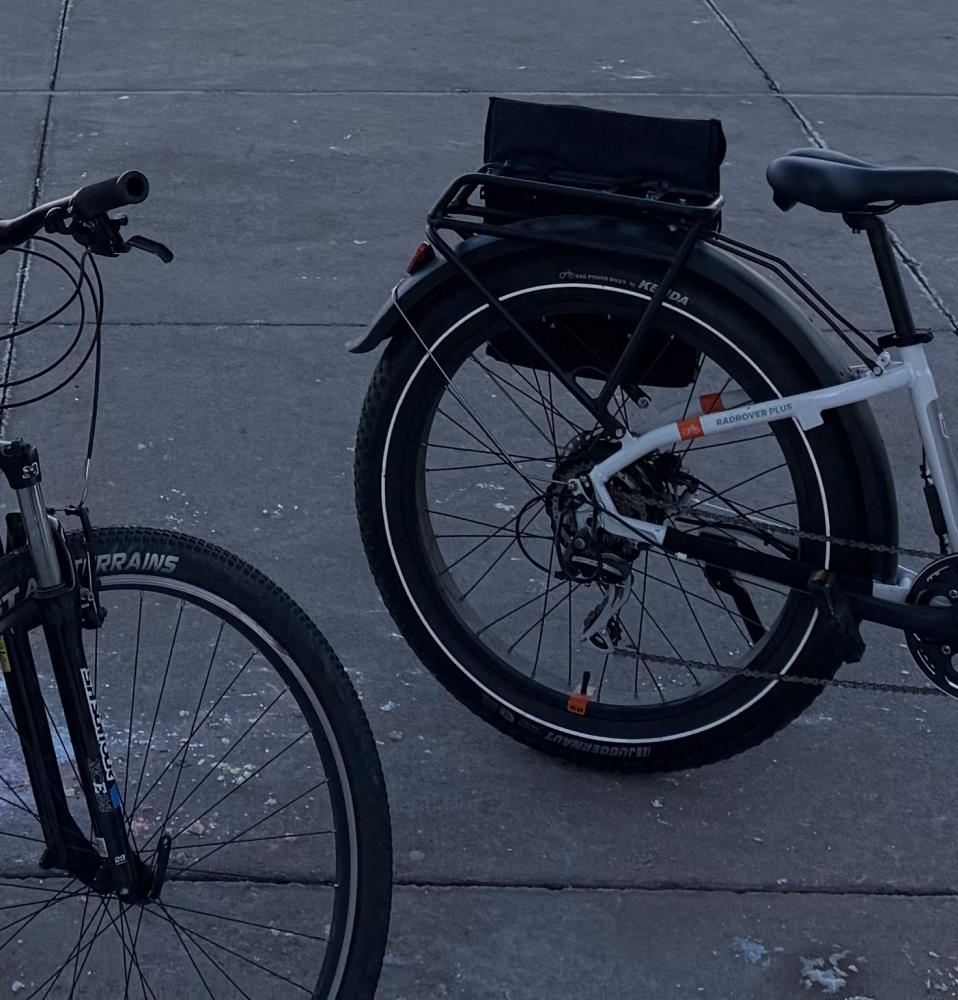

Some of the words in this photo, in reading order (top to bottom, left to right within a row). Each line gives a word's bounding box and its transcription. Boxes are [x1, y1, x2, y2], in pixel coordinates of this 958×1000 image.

[638, 280, 690, 306] KEDA
[716, 409, 767, 426] RADROVER
[768, 403, 793, 416] PLUS
[75, 552, 179, 576] TRRAINS
[544, 731, 638, 757] JUGGERNAUT
